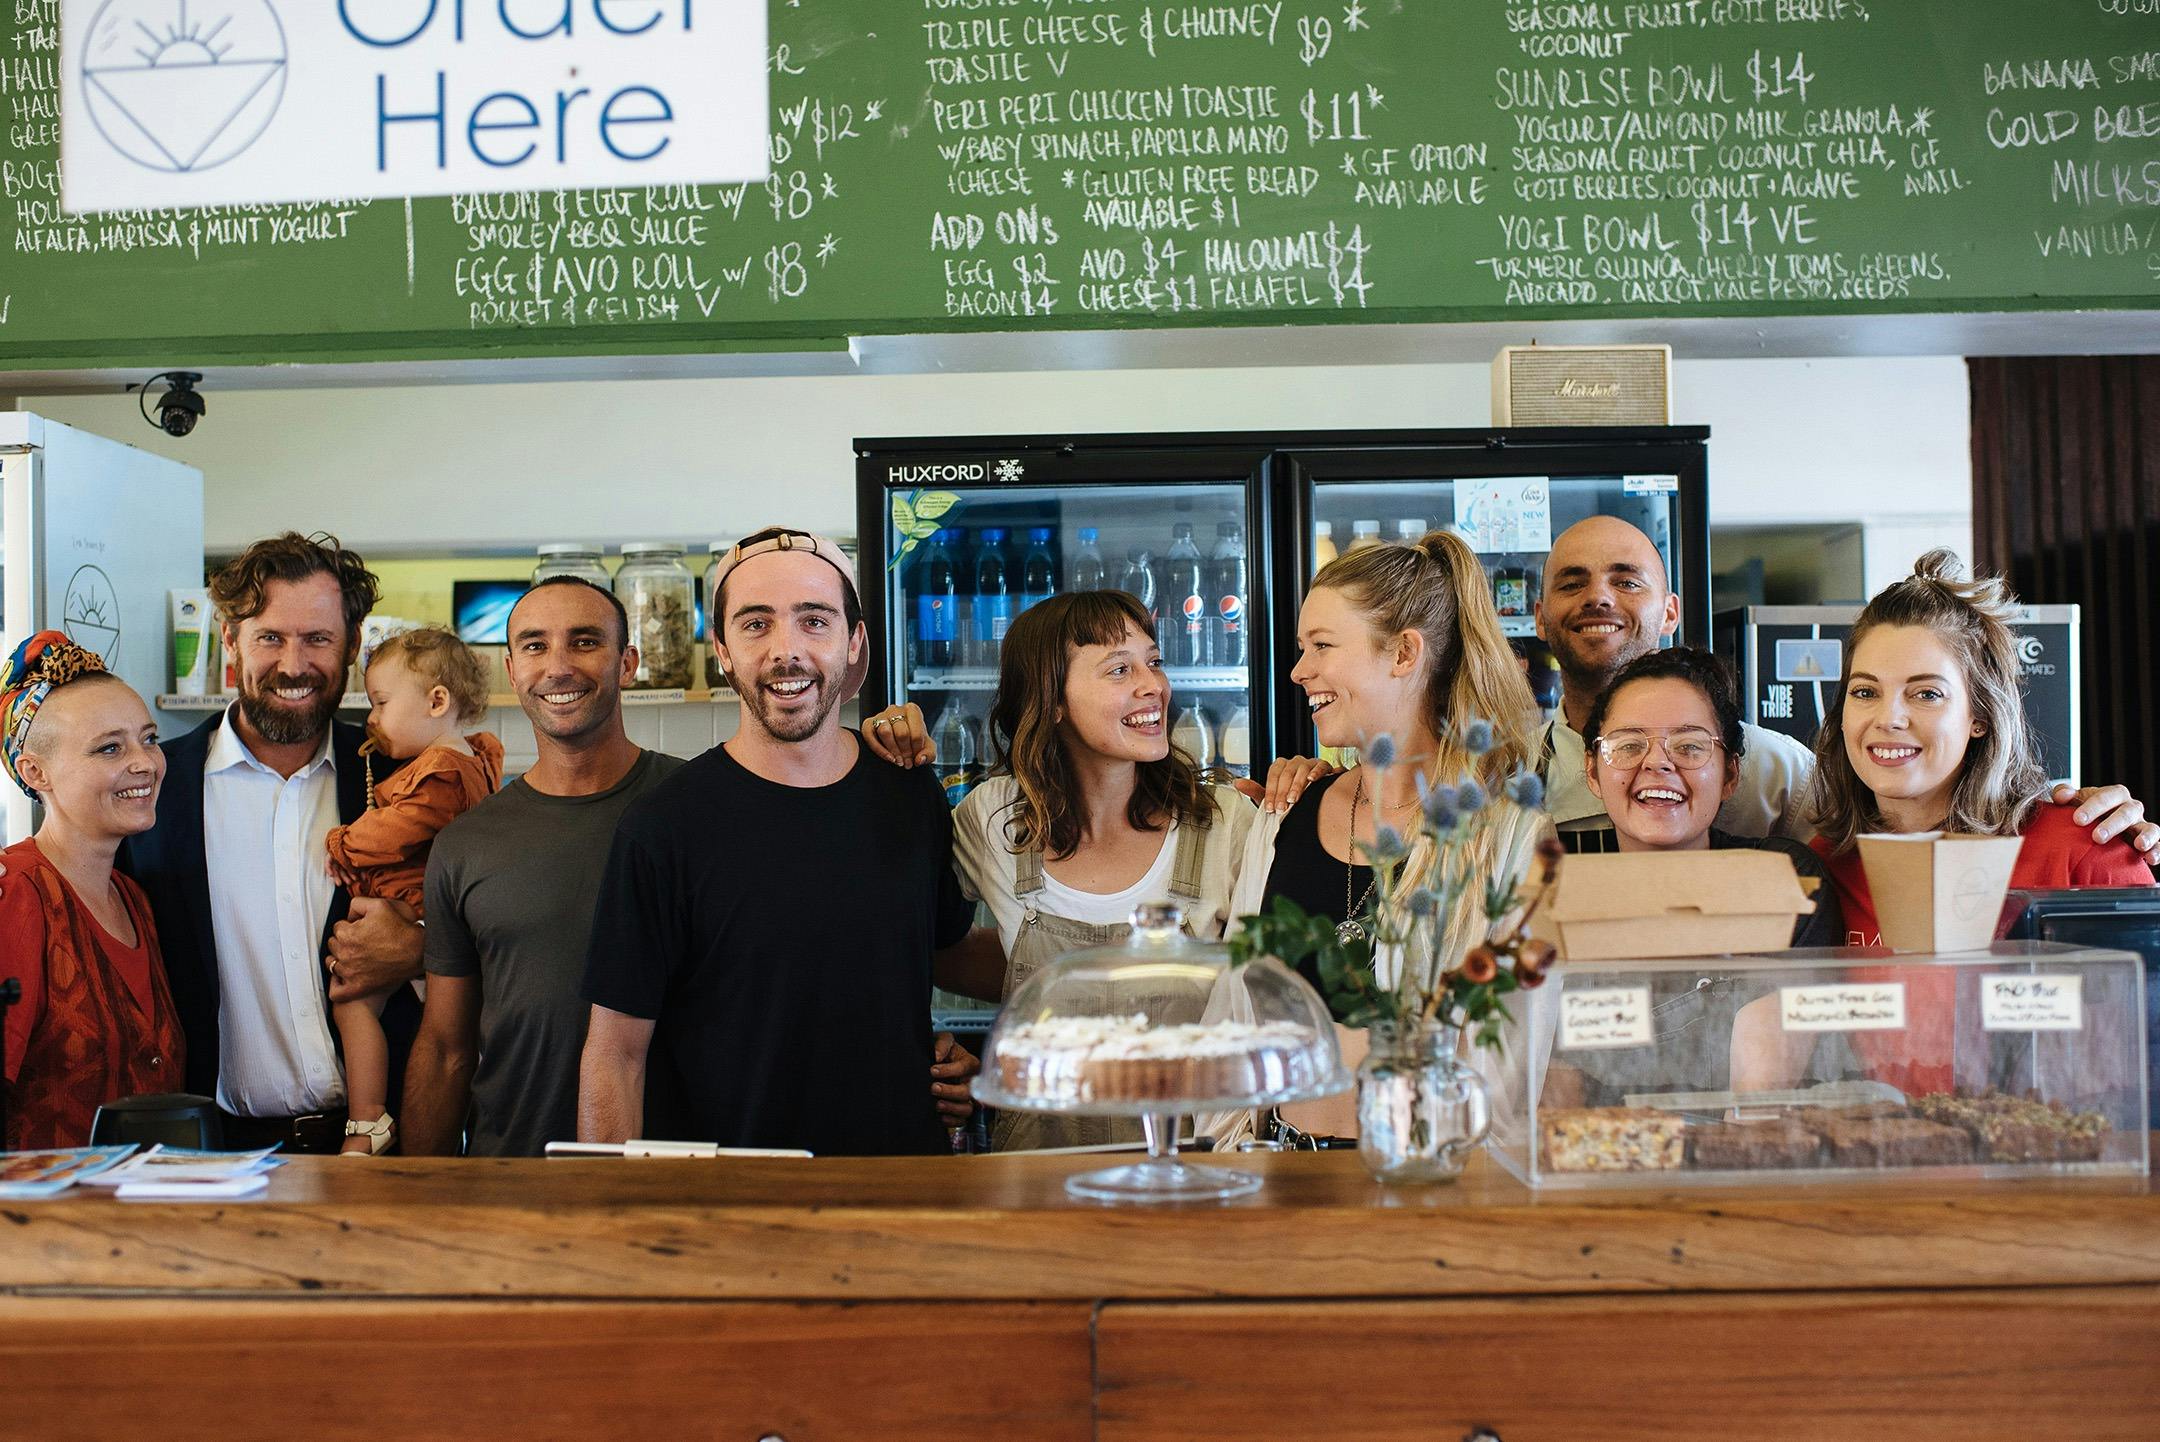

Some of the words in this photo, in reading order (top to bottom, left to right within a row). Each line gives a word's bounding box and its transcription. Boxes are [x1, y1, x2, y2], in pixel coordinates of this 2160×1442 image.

[922, 17, 1014, 50] TRIPLE
[1023, 14, 1129, 46] CHEESE
[1164, 2, 1282, 45] CHUTNEY
[1505, 3, 1618, 32] SEASONAL
[925, 52, 1030, 84] TOASTIE
[1046, 50, 1069, 78] V
[1495, 65, 1635, 111] SUNRISE
[1647, 61, 1736, 107] BOWL
[1746, 49, 1814, 102] $14
[1984, 58, 2100, 95] BANANA
[377, 70, 674, 172] Here
[934, 98, 991, 133] PERI
[1000, 92, 1060, 129] PERI
[1069, 85, 1173, 122] CHICKEN
[1181, 84, 1280, 121] TOASTIE
[1132, 127, 1221, 158] PAPRIKA
[1228, 124, 1289, 156] MAYO
[1986, 107, 2080, 149] COLD
[1410, 143, 1488, 171] OPTION
[1511, 145, 1624, 173] SEASONAL
[1718, 142, 1817, 171] COCONUT
[1911, 138, 1940, 169] GF
[1182, 166, 1235, 195] FREE
[1247, 166, 1319, 198] BREAD
[1355, 177, 1489, 209] AVAILABLE
[1667, 173, 1766, 199] COCONUT
[1781, 168, 1860, 199] AGAVE
[100, 219, 182, 251] HARISSA
[206, 216, 263, 244] MINT
[269, 210, 358, 244] YOGURT
[931, 212, 984, 250] ADD
[1083, 196, 1200, 233] AVAILABLE
[1499, 214, 1572, 252] YOGI
[1584, 212, 1682, 255] BOWL
[1691, 200, 1758, 256] $14
[1769, 204, 1818, 244] VE
[468, 220, 561, 254] SMOKEY
[567, 218, 627, 249] BBQ
[630, 215, 708, 246] SAUCE
[1204, 231, 1324, 276] HALOUMI
[1323, 221, 1371, 268] $4
[456, 255, 517, 299] EGG
[554, 254, 619, 298] AVO
[633, 252, 712, 291] ROLL
[945, 259, 994, 289] EGG
[1013, 253, 1060, 288] $2
[1080, 248, 1125, 280] AVO
[1142, 236, 1187, 279] $4
[1475, 254, 1589, 281] TURMERIC
[1697, 252, 1777, 281] CHERRY
[945, 289, 1018, 317] BACON
[1079, 279, 1164, 310] CHEESE
[1165, 275, 1201, 312] $1
[1210, 276, 1320, 309] FALAFEL
[1328, 265, 1374, 308] $4
[1714, 279, 1764, 301] KALE
[470, 297, 553, 328] ROCKET
[888, 465, 983, 482] HUXFORD
[1761, 700, 1793, 718] TRIBE
[1768, 684, 1793, 701] VIBE
